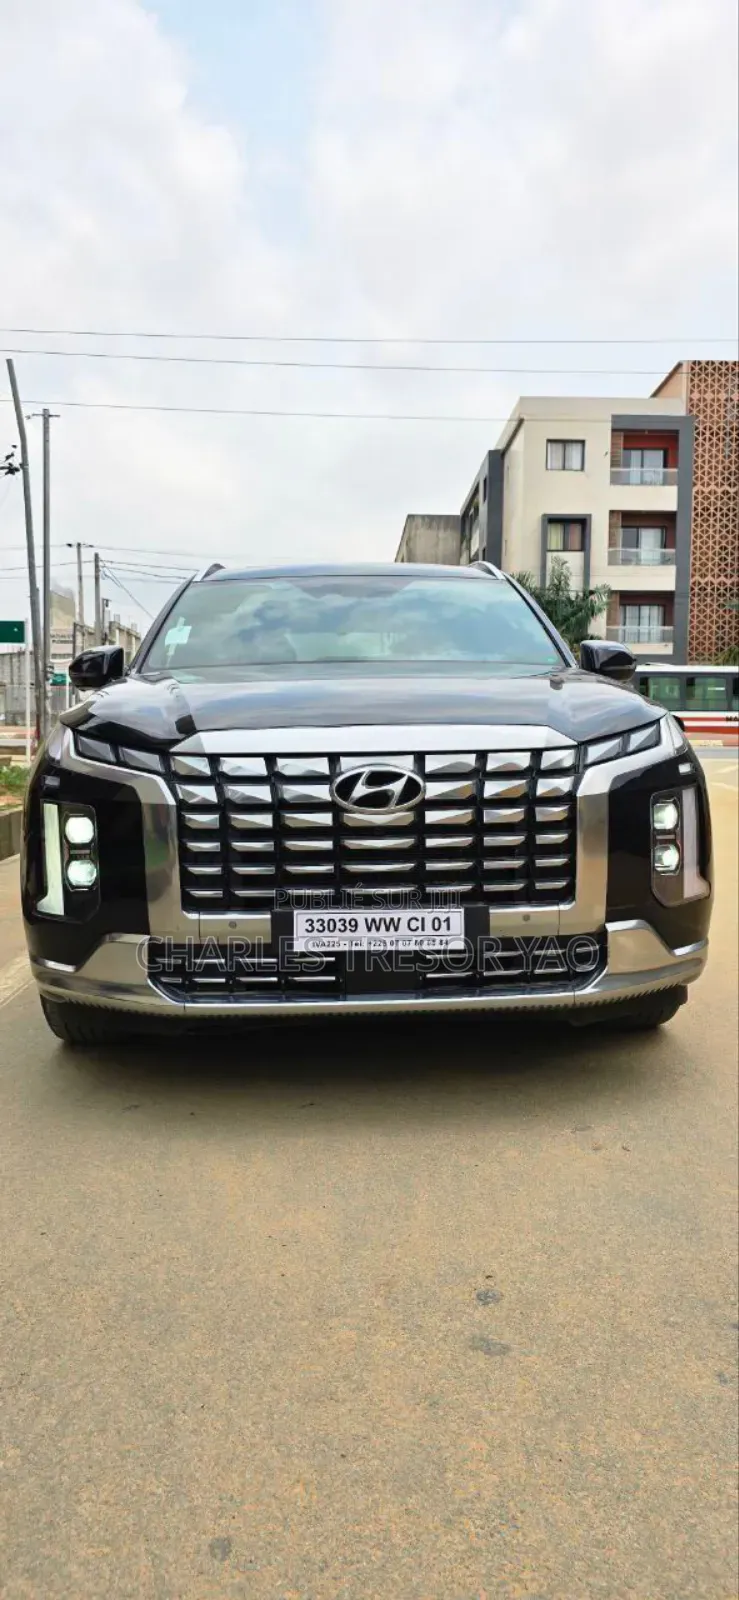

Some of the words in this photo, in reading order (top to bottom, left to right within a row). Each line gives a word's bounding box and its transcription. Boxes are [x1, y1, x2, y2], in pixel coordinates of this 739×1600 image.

[304, 917, 359, 933] 33039
[364, 917, 401, 932] WW
[407, 917, 426, 932] CI
[431, 916, 451, 931] 01
